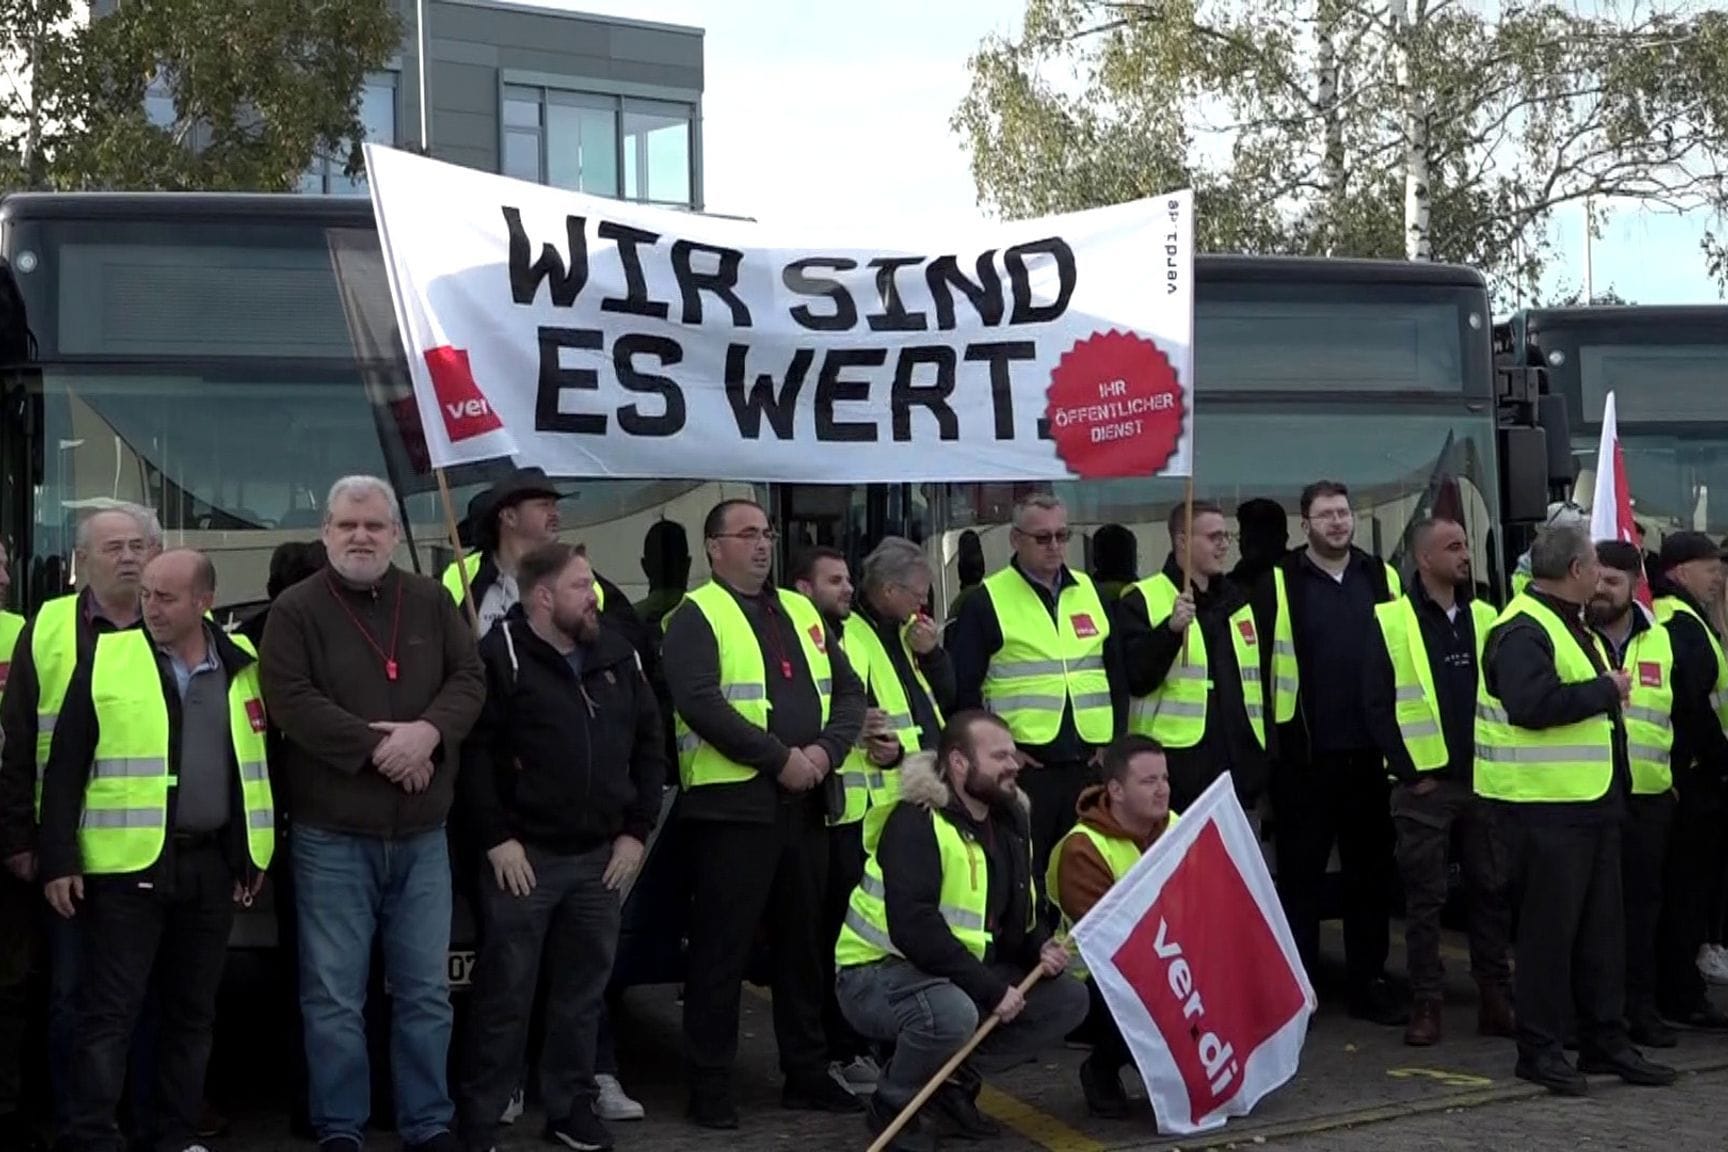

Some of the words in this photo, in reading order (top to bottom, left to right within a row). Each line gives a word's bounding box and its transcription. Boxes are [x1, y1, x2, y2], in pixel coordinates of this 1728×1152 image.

[501, 205, 752, 327] WIR
[782, 236, 1077, 331] SIND
[535, 326, 686, 437] ES
[724, 341, 1055, 442] WERT.
[1098, 379, 1127, 398] IHR
[1055, 392, 1175, 427] ÖFFENTLICHER
[1091, 419, 1144, 443] DIENST
